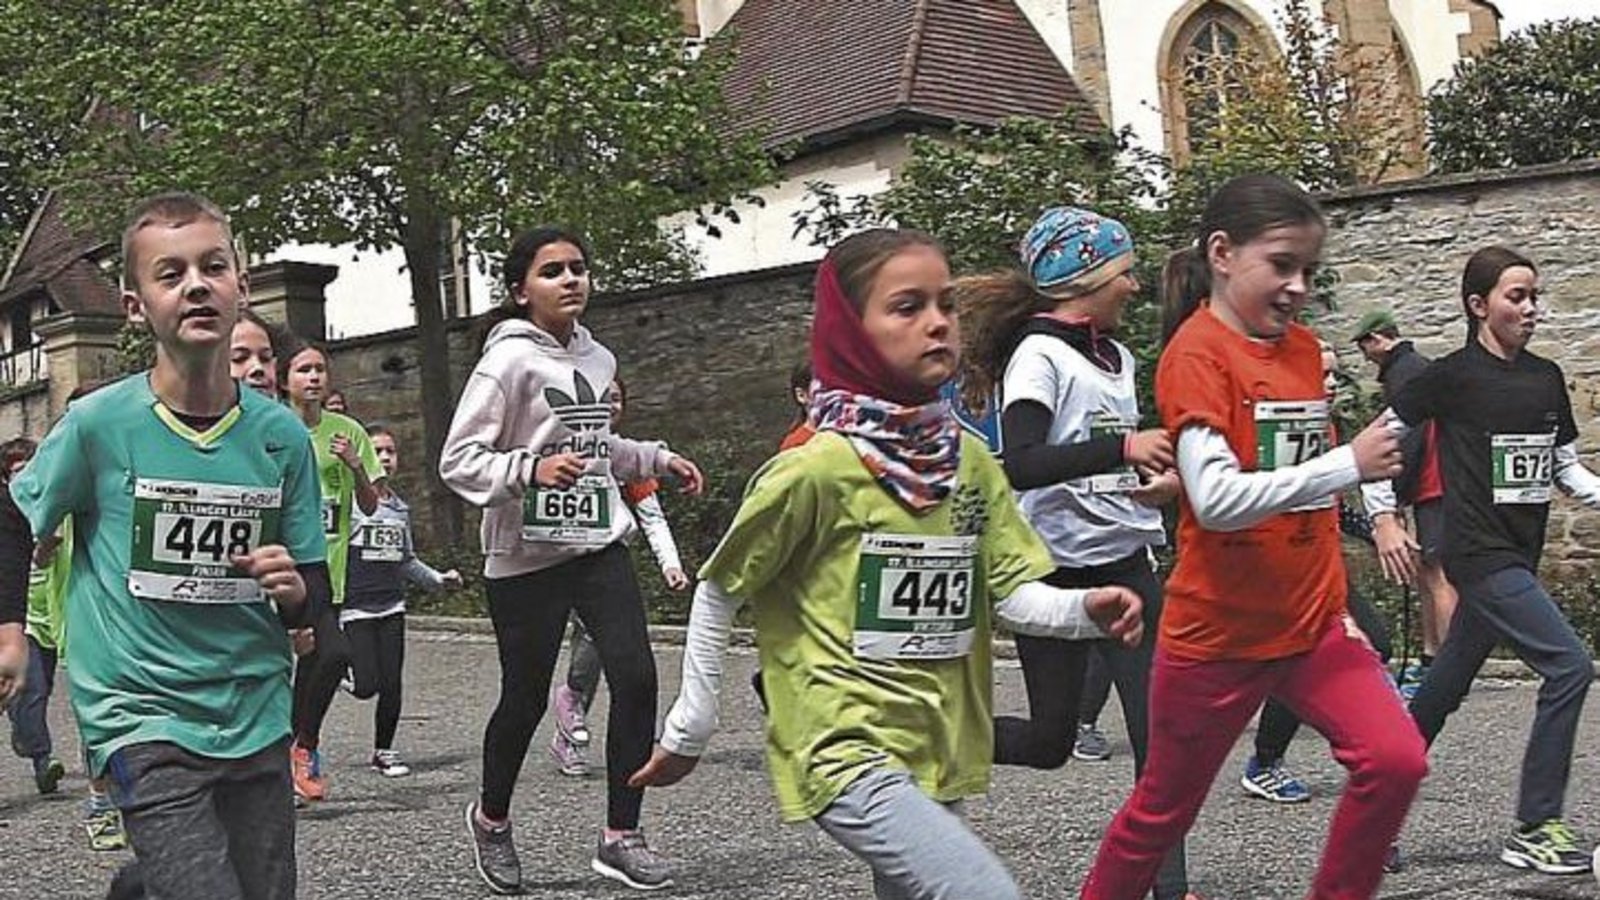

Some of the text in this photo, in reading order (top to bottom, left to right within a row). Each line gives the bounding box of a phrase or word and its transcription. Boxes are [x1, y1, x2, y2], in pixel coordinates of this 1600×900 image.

[541, 435, 613, 459] adida
[545, 493, 593, 519] 664
[166, 516, 252, 562] 448
[892, 571, 969, 617] 443
